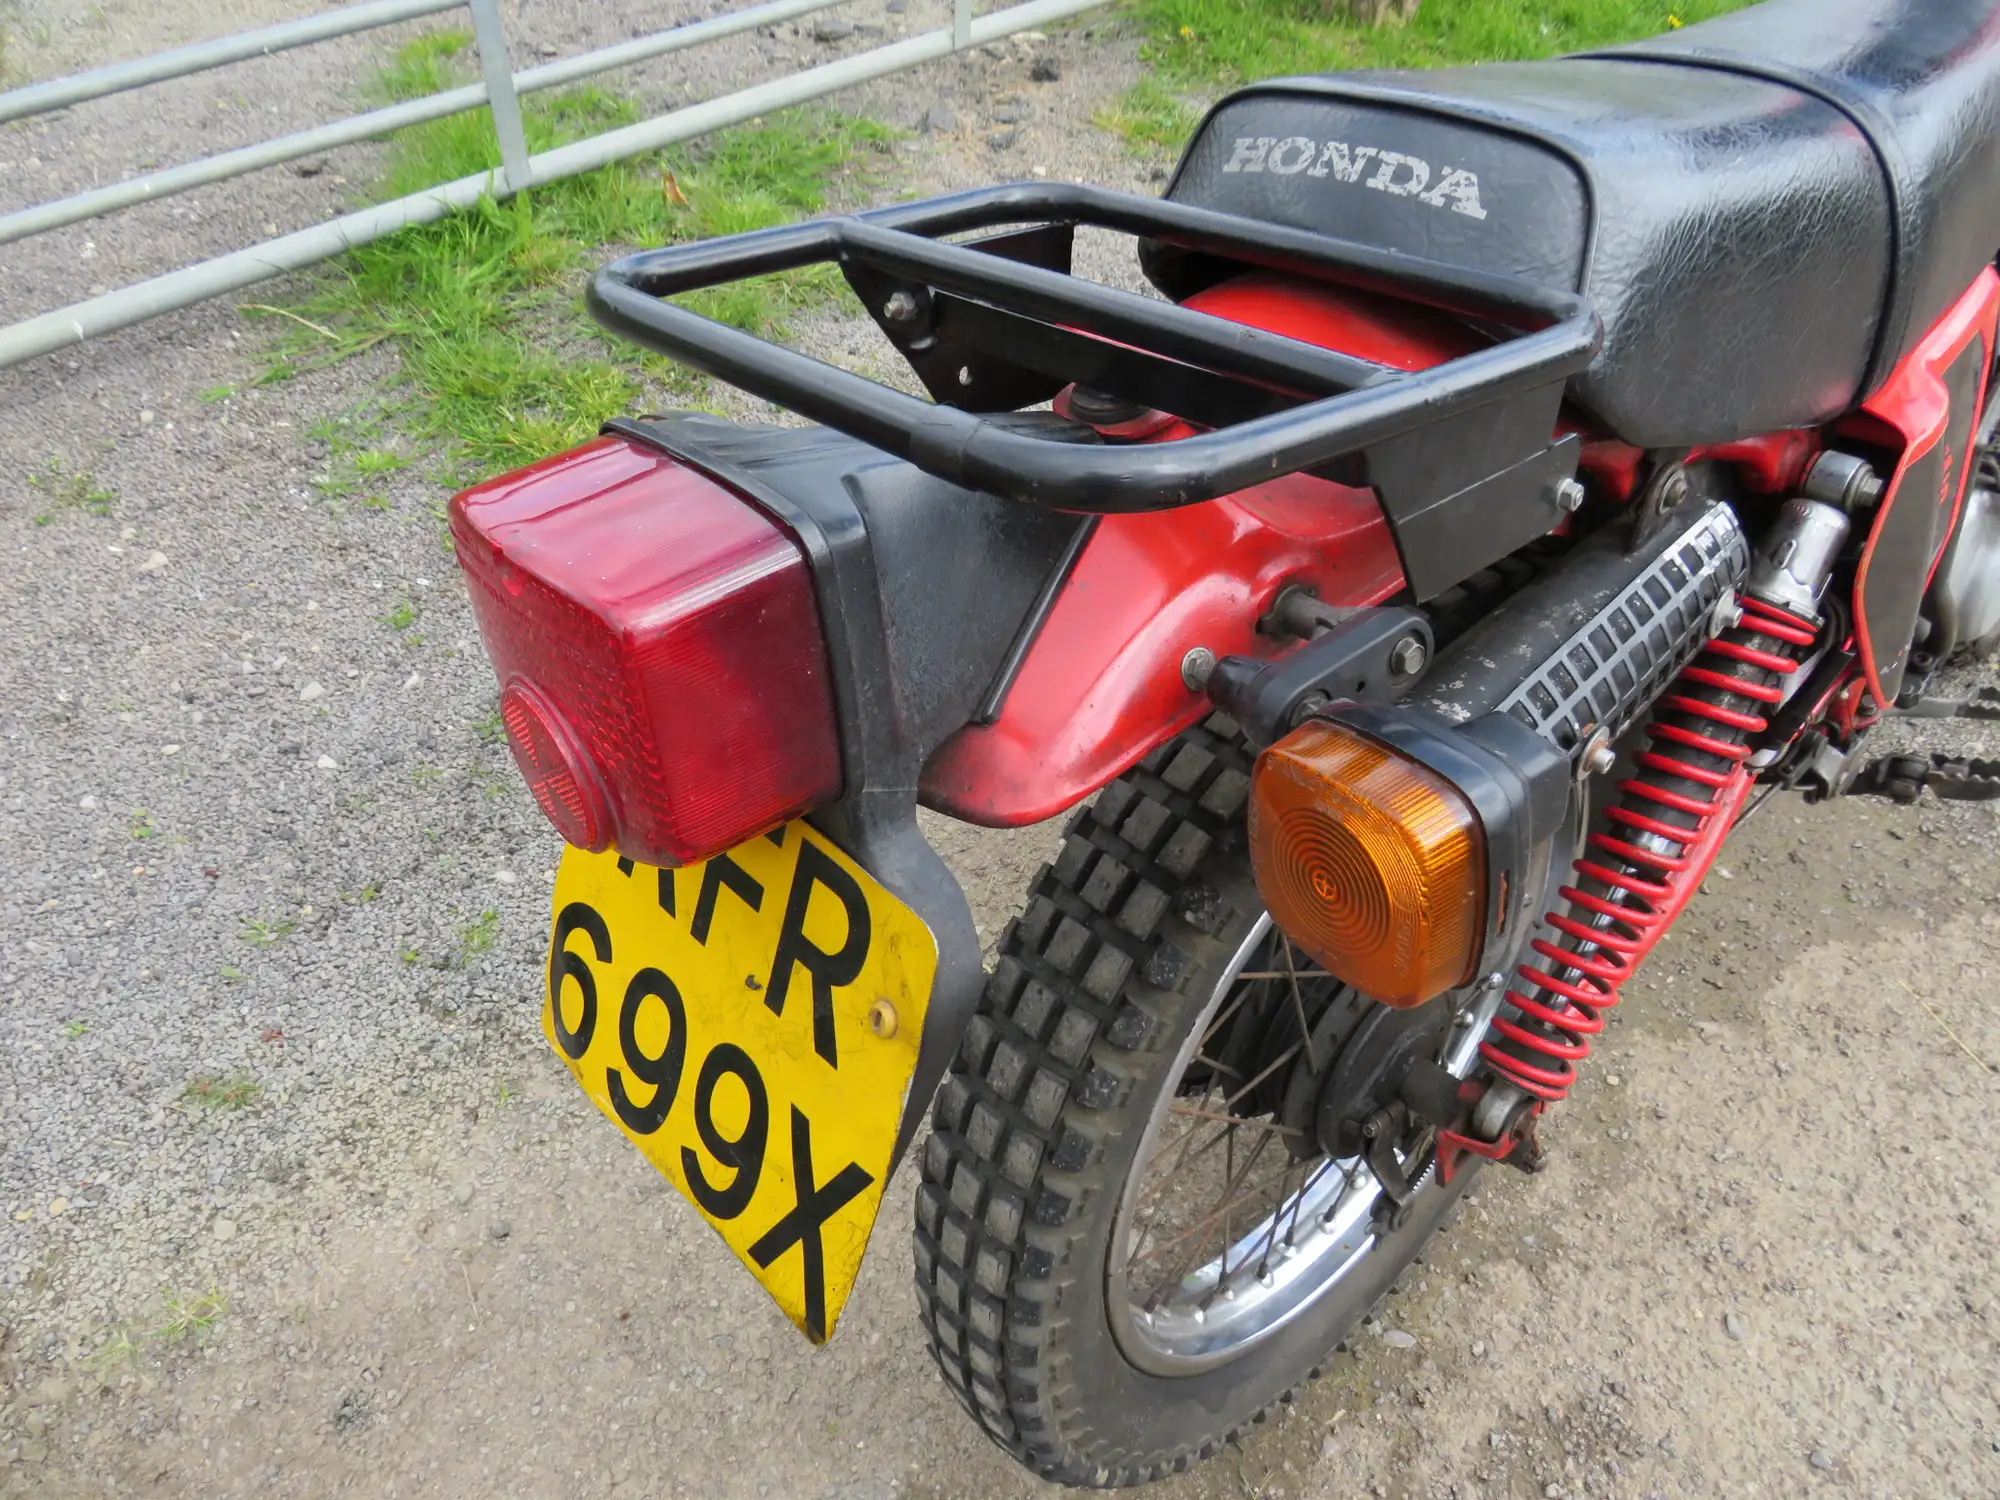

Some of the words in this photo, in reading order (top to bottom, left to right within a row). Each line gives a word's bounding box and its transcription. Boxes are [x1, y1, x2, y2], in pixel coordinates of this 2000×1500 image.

[1222, 136, 1487, 220] HONDA
[617, 824, 871, 1071] FR
[549, 902, 875, 1344] 699X
